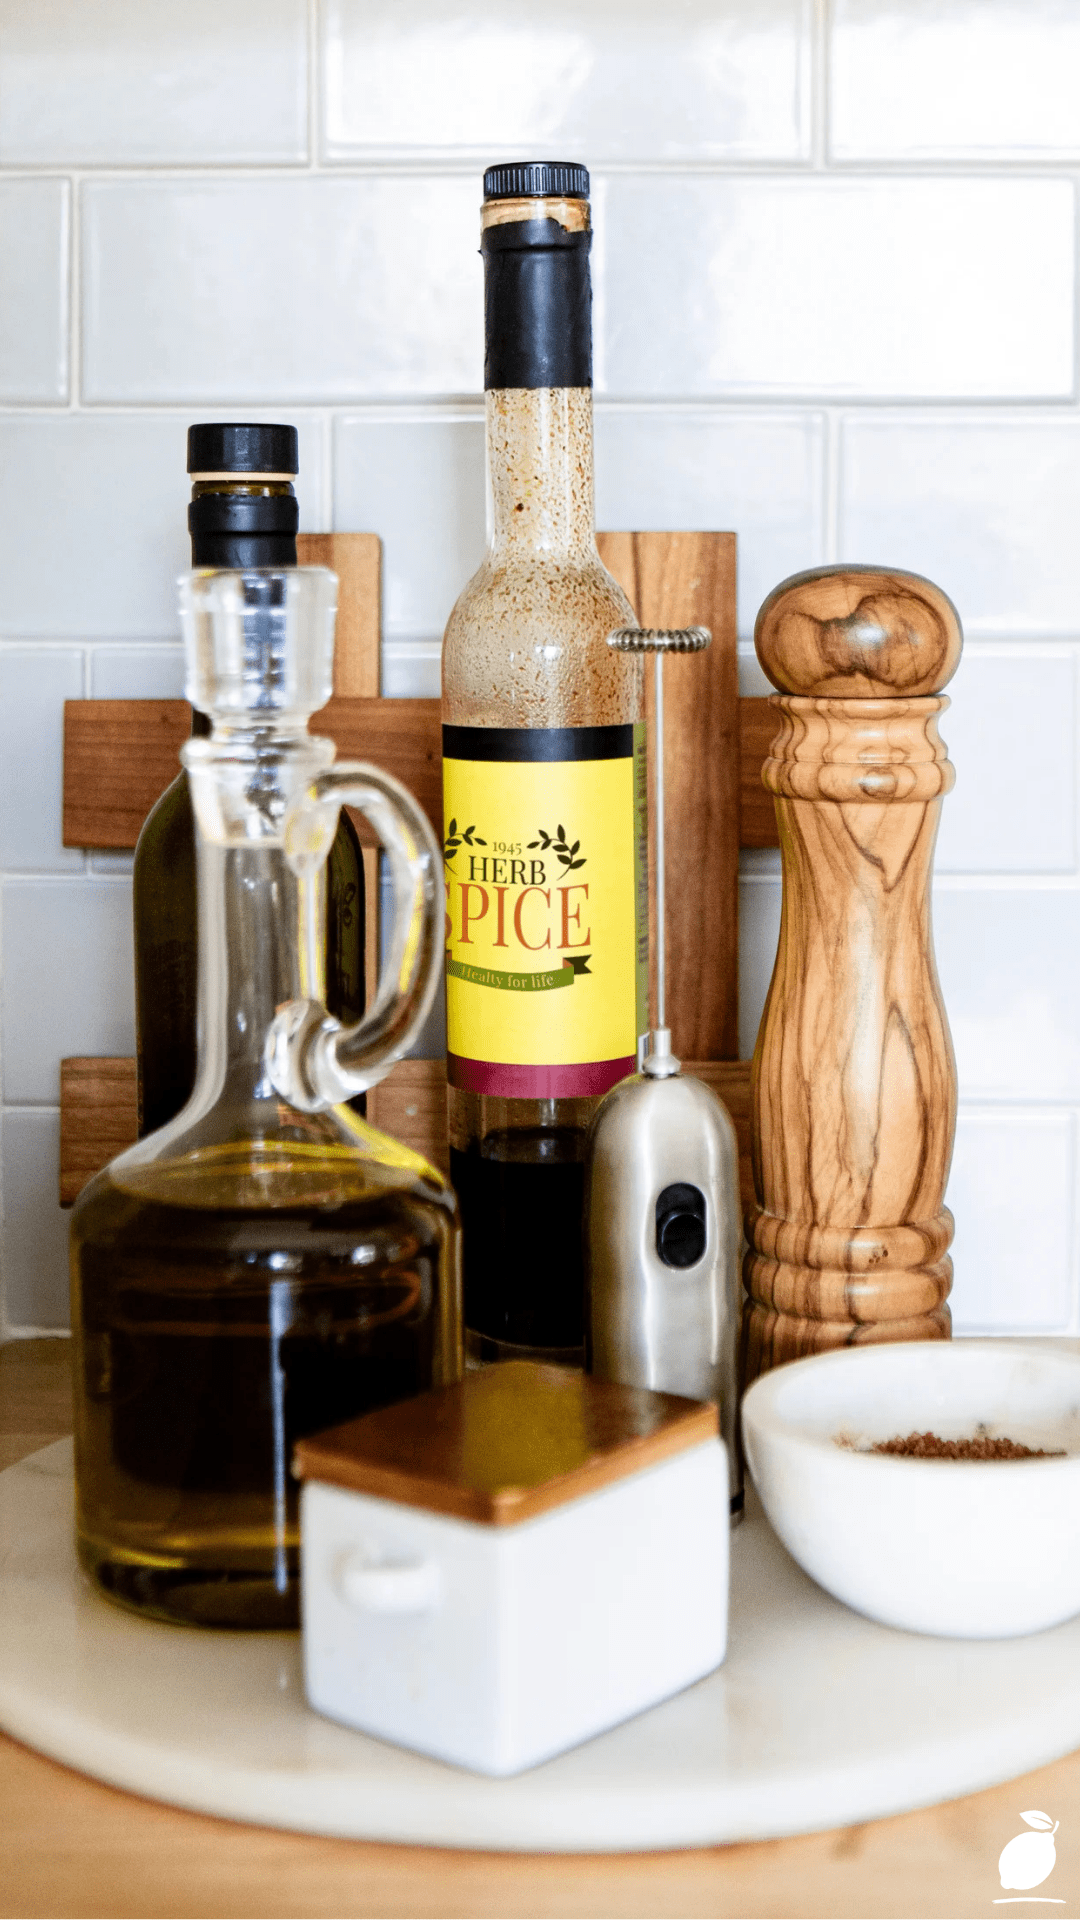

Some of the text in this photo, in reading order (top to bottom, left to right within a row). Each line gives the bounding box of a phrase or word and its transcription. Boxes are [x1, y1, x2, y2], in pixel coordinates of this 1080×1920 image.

[492, 841, 522, 855] 1945
[468, 855, 546, 885] HERB
[461, 966, 554, 988] Healty for life
